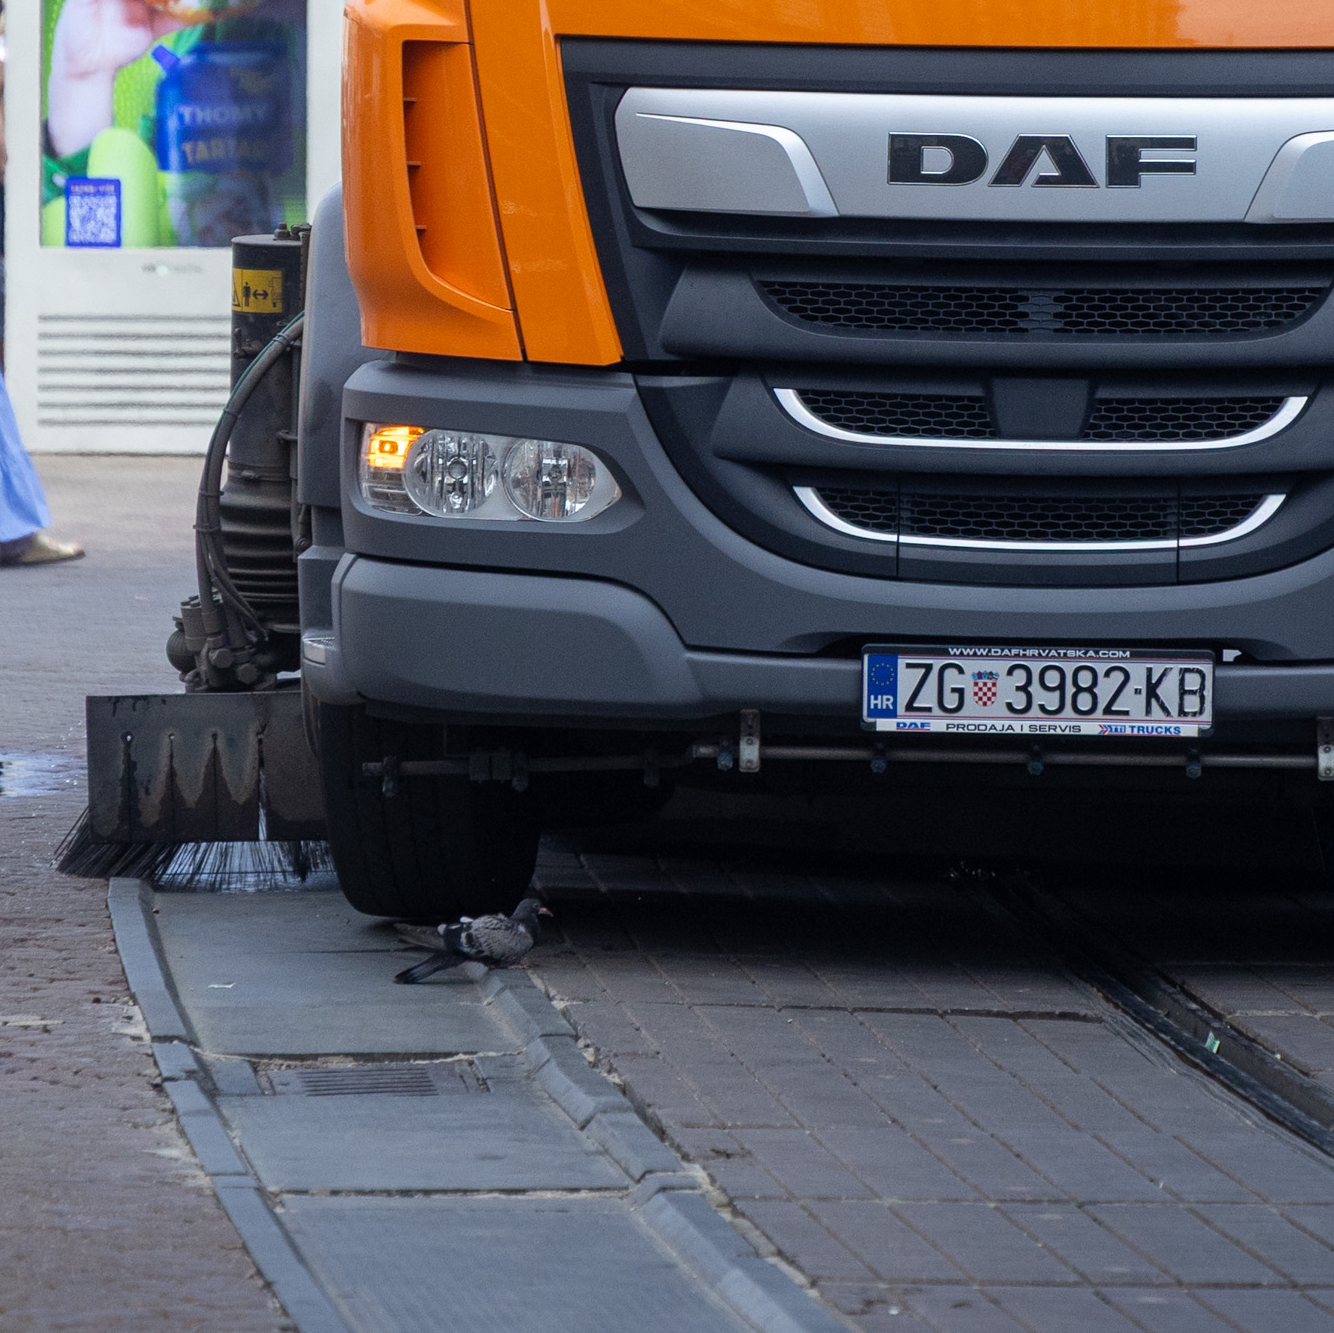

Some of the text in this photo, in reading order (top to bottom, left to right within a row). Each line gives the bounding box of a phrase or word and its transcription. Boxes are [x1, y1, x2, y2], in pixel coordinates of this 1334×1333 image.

[887, 130, 1197, 189] DAF
[948, 647, 1131, 658] WWW.DAFHRVATSKA.COM
[904, 662, 965, 714] ZG
[870, 695, 894, 709] HR
[946, 723, 1015, 732] PRODAJA
[1028, 724, 1082, 733] SERVIS
[1129, 726, 1181, 735] TRUCKS
